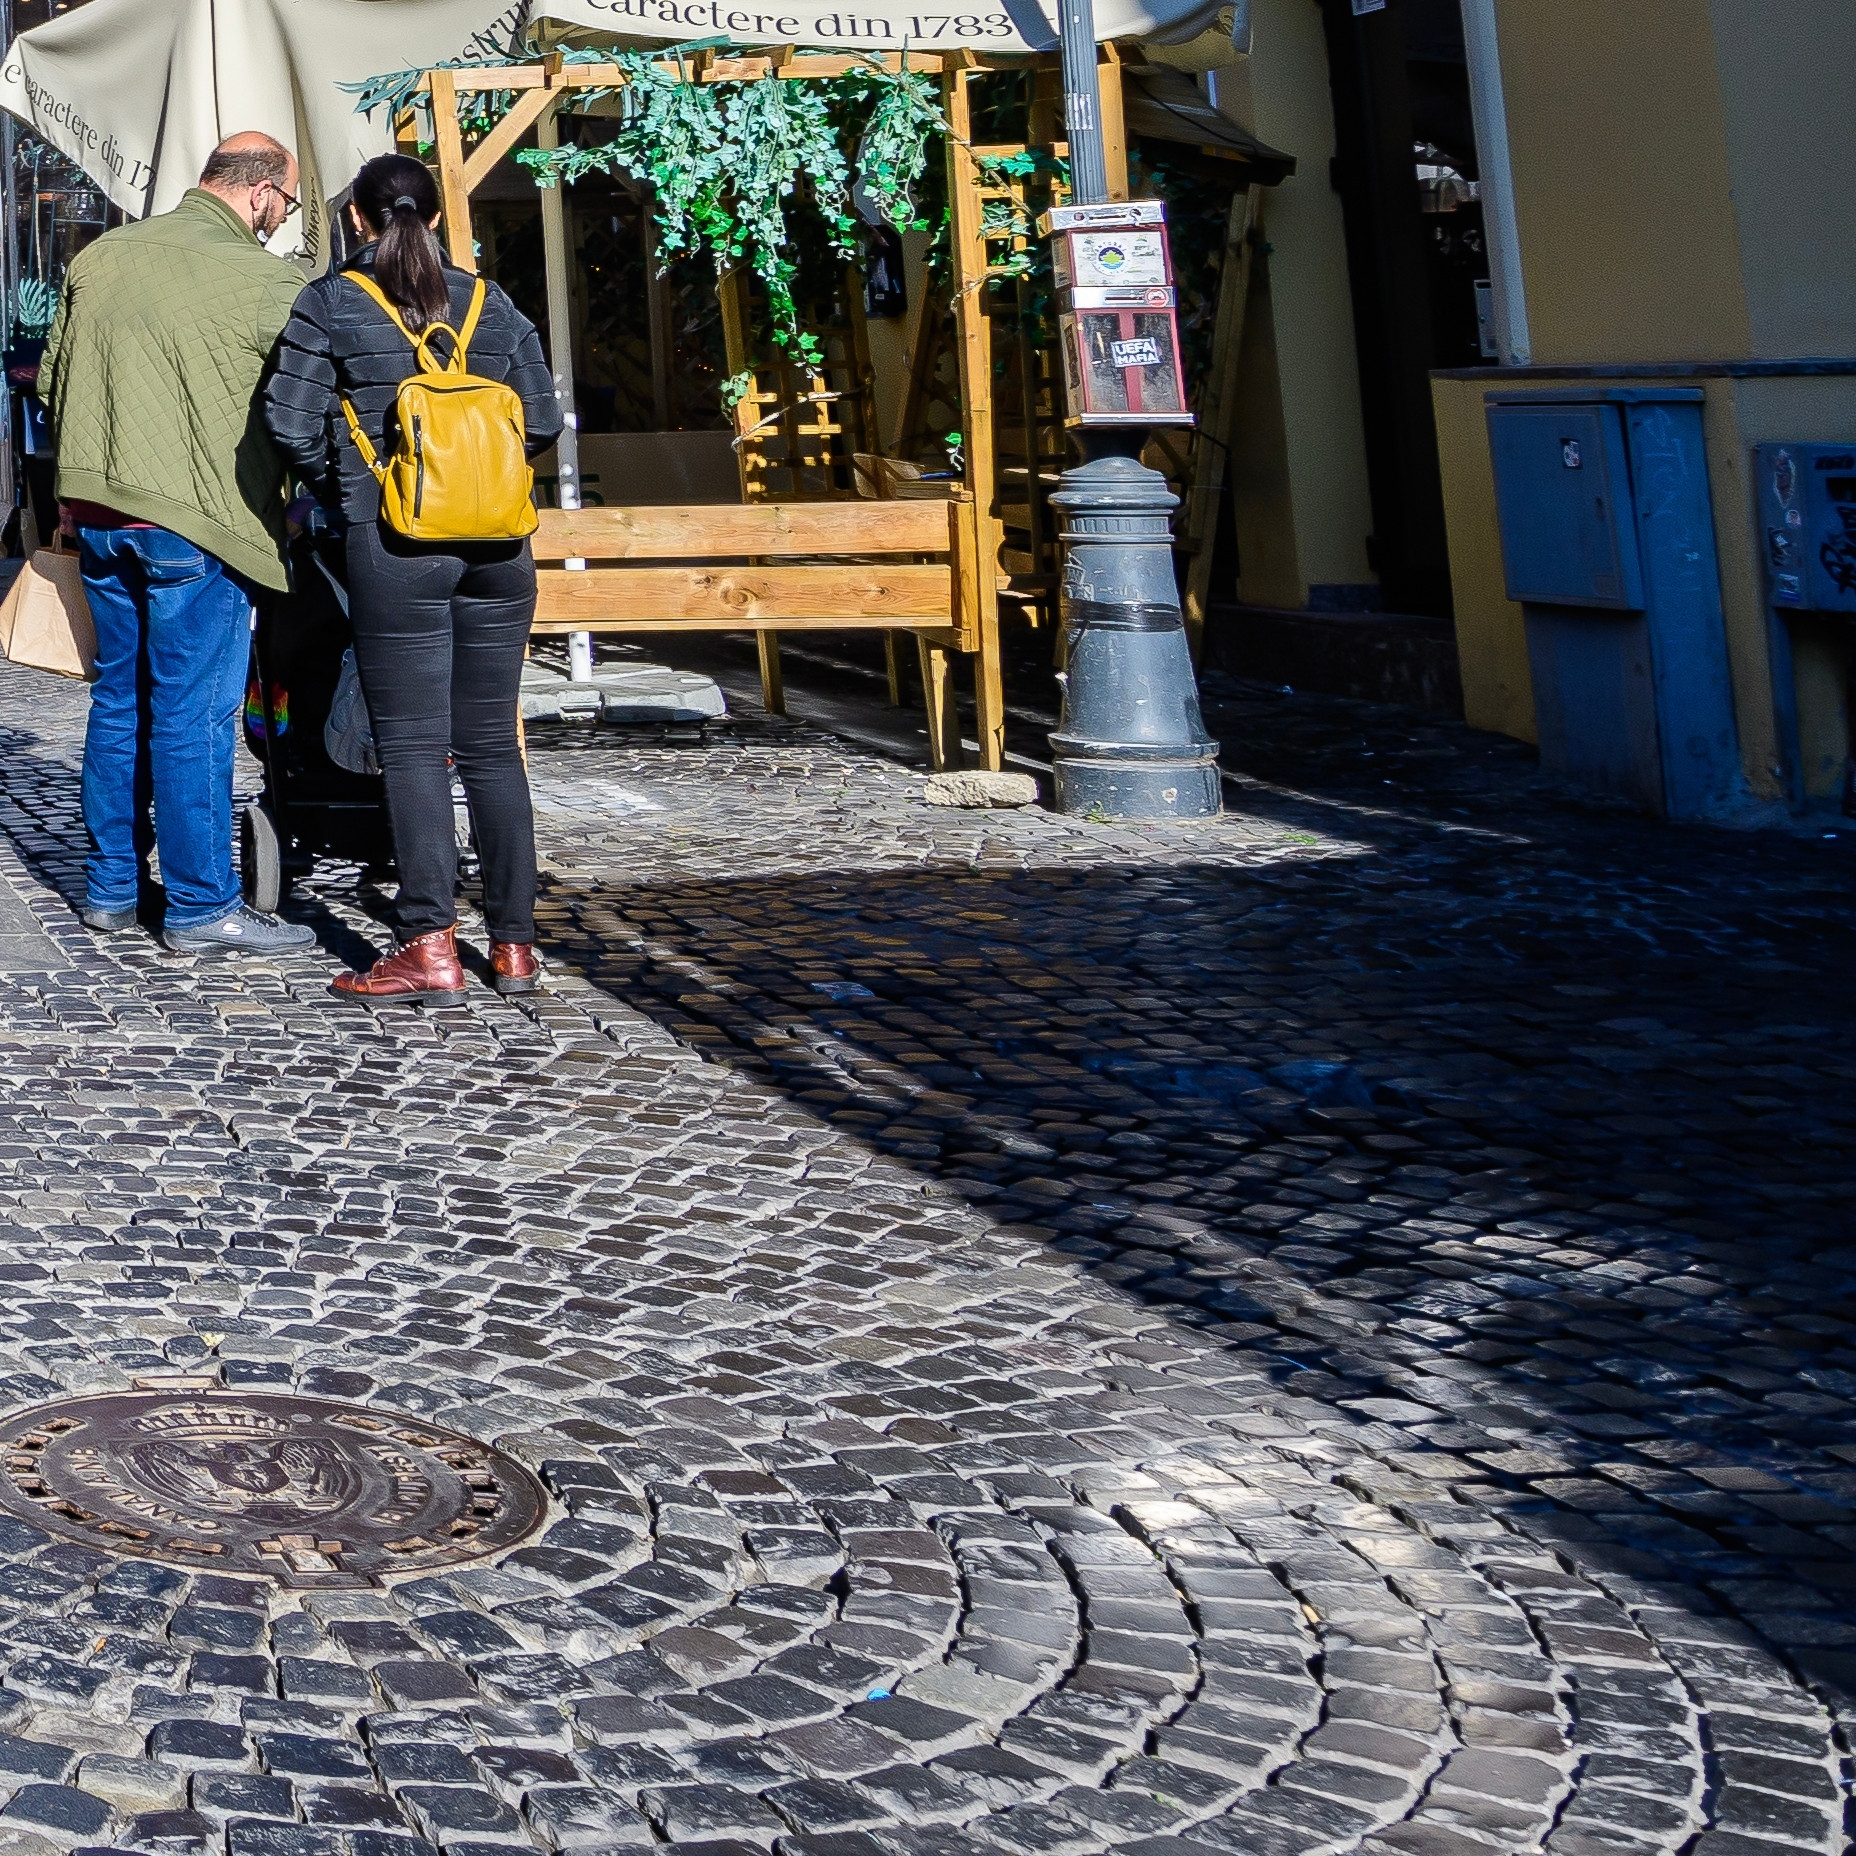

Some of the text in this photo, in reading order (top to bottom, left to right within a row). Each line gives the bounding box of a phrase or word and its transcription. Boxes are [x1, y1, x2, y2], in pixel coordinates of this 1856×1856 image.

[813, 8, 894, 39] din
[905, 12, 1013, 39] 1783
[1115, 341, 1154, 355] UEFA
[1117, 352, 1160, 365] MAFIA
